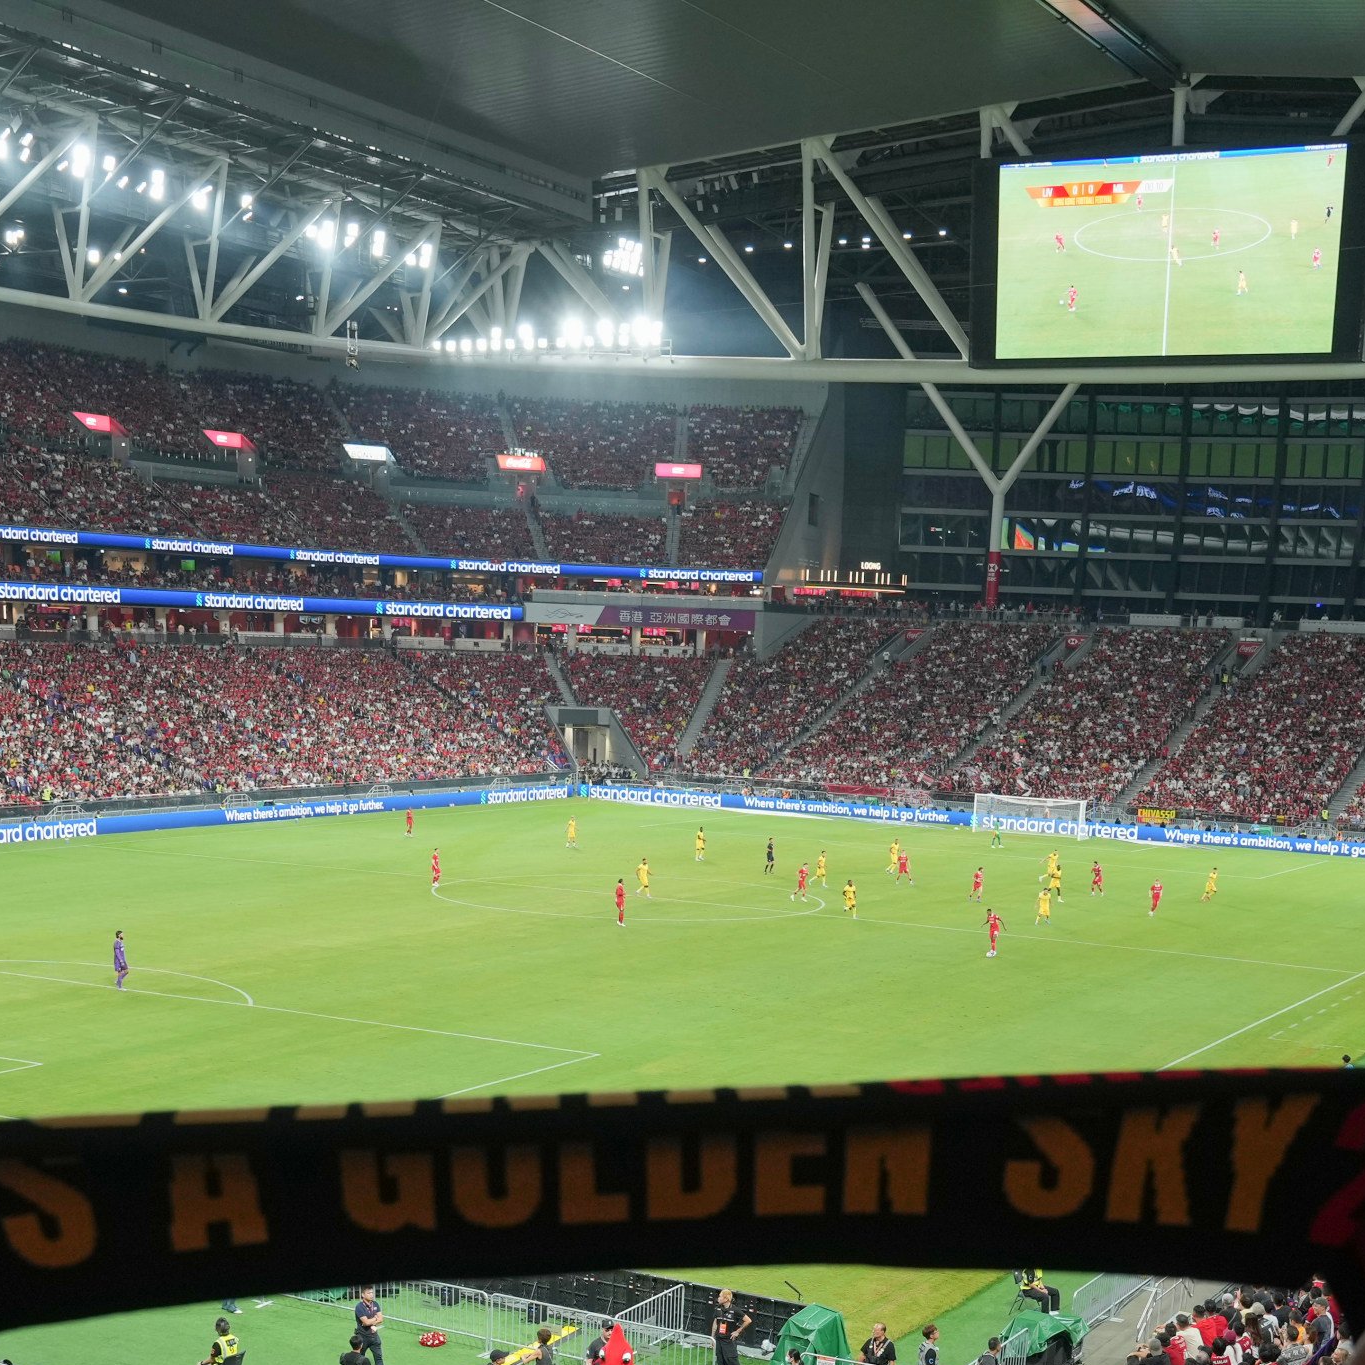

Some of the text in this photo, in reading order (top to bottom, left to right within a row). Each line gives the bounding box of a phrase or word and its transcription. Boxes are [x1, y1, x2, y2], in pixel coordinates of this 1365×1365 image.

[30, 530, 78, 544] chartered
[152, 538, 233, 555] standard chartered
[295, 549, 379, 566] standard chartered
[861, 562, 881, 570] LOONG
[458, 559, 561, 575] standard chartered
[648, 568, 753, 582] standard chartered
[60, 588, 121, 604] chartered
[205, 593, 304, 611] standard chartered
[385, 602, 511, 619] standard chartered
[619, 611, 643, 623] 香港
[488, 786, 568, 804] standard chartered
[590, 785, 721, 808] standard chartered
[225, 810, 251, 821] Where
[253, 807, 278, 819] there's
[279, 805, 314, 818] ambition,
[315, 807, 325, 815] we
[326, 804, 341, 816] help
[349, 805, 358, 814] go
[359, 800, 384, 810] further.
[744, 797, 950, 823] Where there's ambition, we help it go further.
[25, 819, 97, 841] chartered
[982, 814, 1138, 840] standard chartered
[1164, 828, 1200, 843] Where
[1202, 831, 1238, 845] there's
[1240, 834, 1293, 851] ambition,
[1295, 842, 1312, 852] we
[1314, 840, 1339, 857] help
[1340, 842, 1349, 853] it
[169, 1152, 272, 1255] A
[1004, 1093, 1320, 1234] SKY
